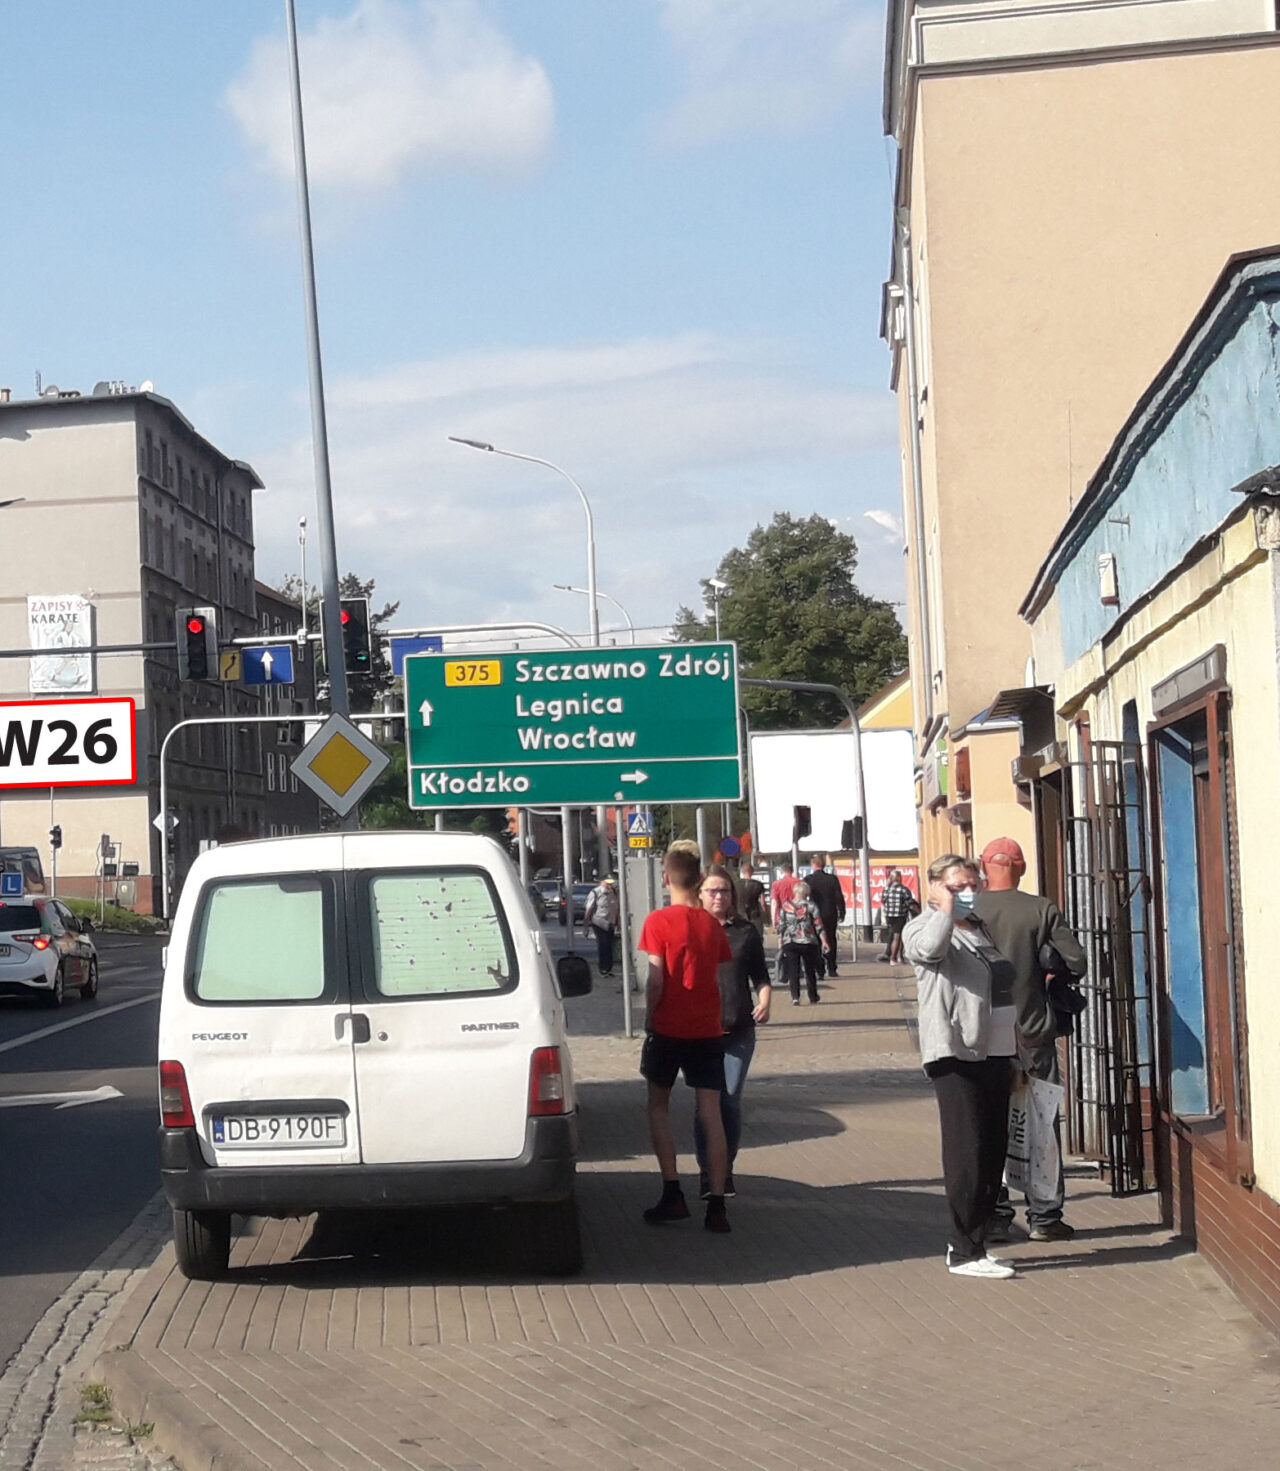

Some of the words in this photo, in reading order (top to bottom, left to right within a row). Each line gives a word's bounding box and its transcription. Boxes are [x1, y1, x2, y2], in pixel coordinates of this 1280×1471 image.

[31, 602, 73, 612] ZAPISY
[31, 613, 80, 624] KARATE
[456, 665, 489, 681] 375
[516, 660, 646, 682] Szczawno
[658, 652, 731, 681] Zdrój
[516, 693, 623, 721] Legnica
[517, 727, 636, 750] Wrocław
[421, 771, 530, 794] Kłodzko
[7, 876, 17, 891] L
[461, 1022, 519, 1031] PARTNER
[228, 1119, 260, 1140] DB
[269, 1116, 337, 1140] 9190F
